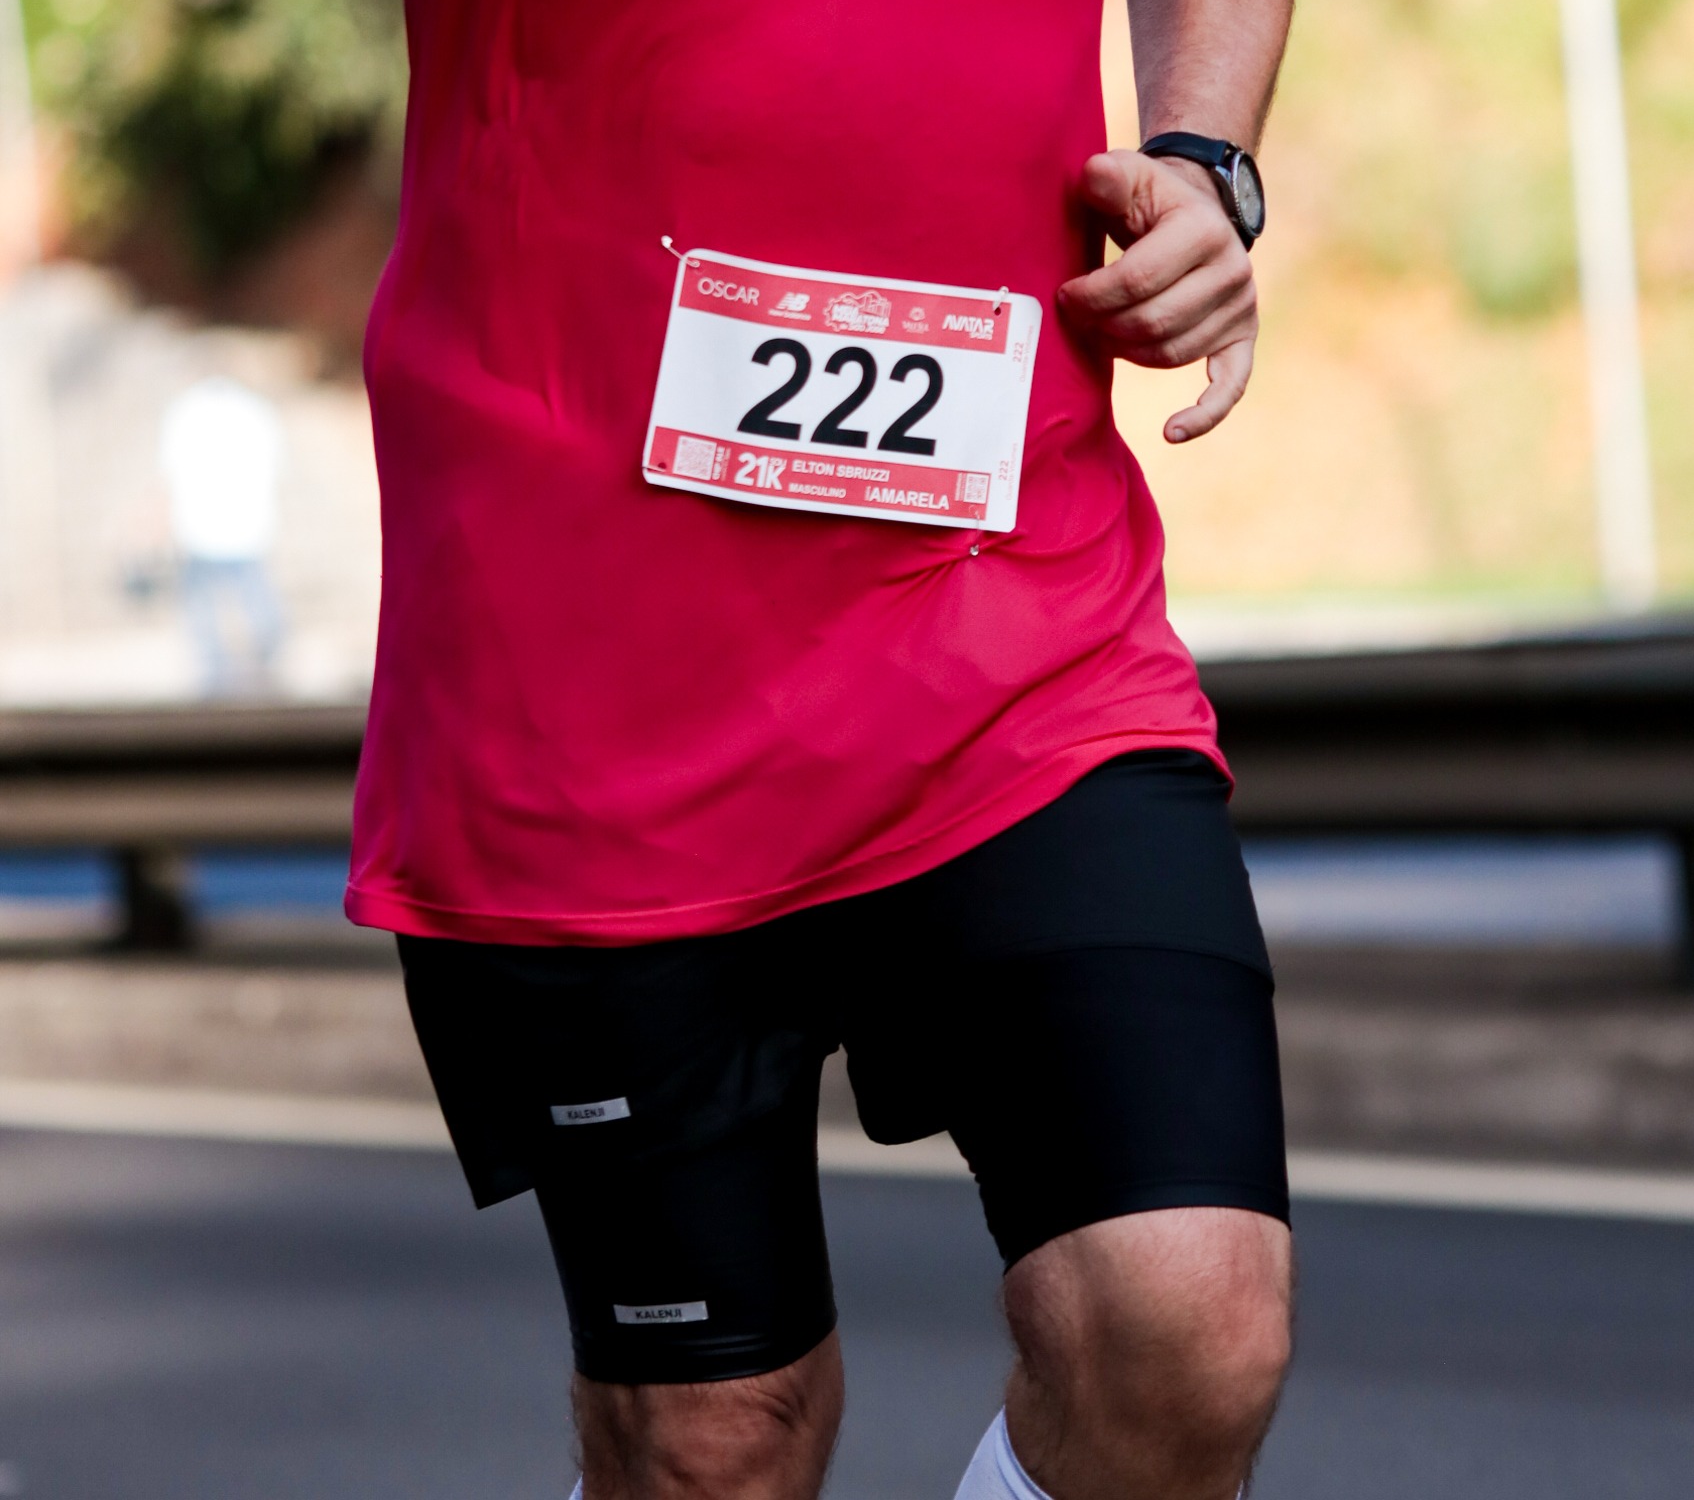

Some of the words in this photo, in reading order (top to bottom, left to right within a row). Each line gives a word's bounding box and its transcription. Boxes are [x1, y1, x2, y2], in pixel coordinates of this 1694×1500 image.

[697, 277, 761, 306] OSCAR
[942, 314, 995, 335] AVATAR
[1012, 341, 1025, 364] 222
[736, 337, 944, 457] 222
[734, 452, 786, 491] 21K
[791, 459, 835, 477] ELTON
[836, 464, 890, 483] SBRUZZI
[998, 459, 1010, 482] 222
[788, 482, 847, 499] MASCULINO
[868, 486, 950, 511] AMARELA
[635, 1308, 682, 1320] KALENJI
